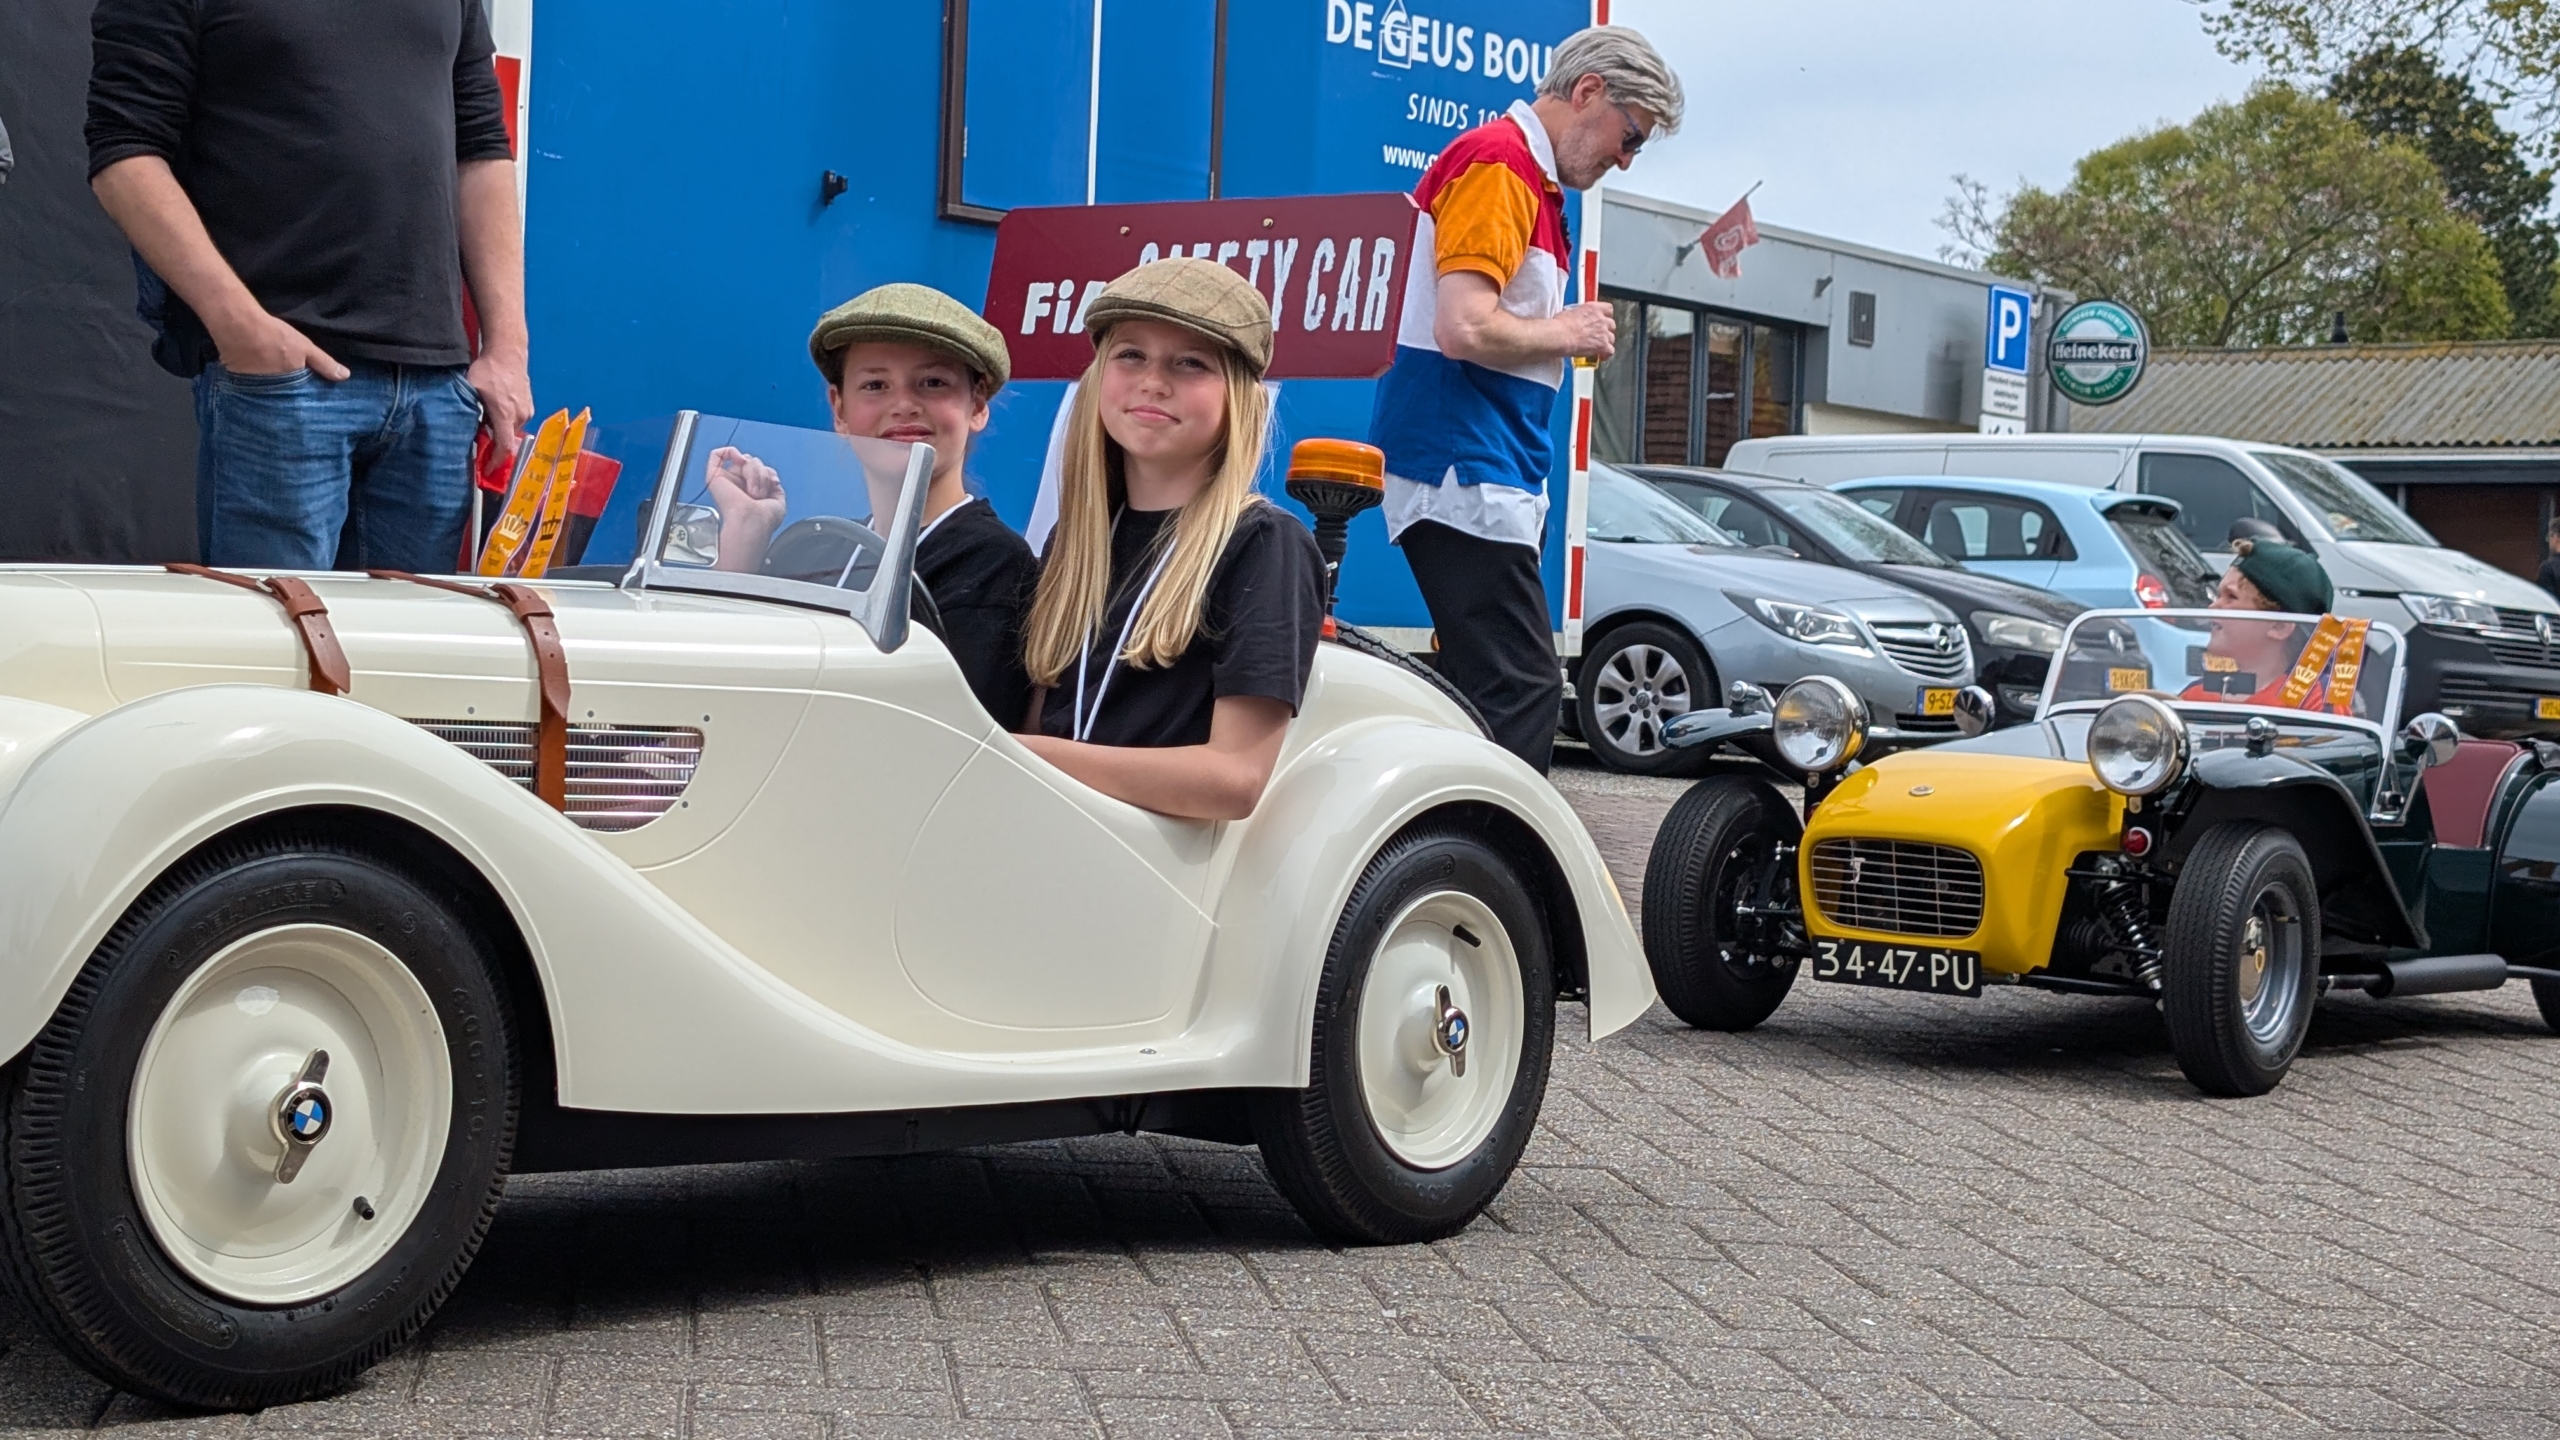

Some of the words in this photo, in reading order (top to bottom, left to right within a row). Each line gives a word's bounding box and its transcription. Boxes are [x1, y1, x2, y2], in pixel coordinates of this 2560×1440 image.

[1326, 0, 1374, 50] DE
[1383, 10, 1474, 73] GEUS
[1406, 93, 1469, 130] SINDS
[1304, 236, 1396, 332] CAR
[1997, 297, 2022, 361] P
[2055, 343, 2132, 361] Heineken
[1817, 941, 1974, 991] 34-47-PU
